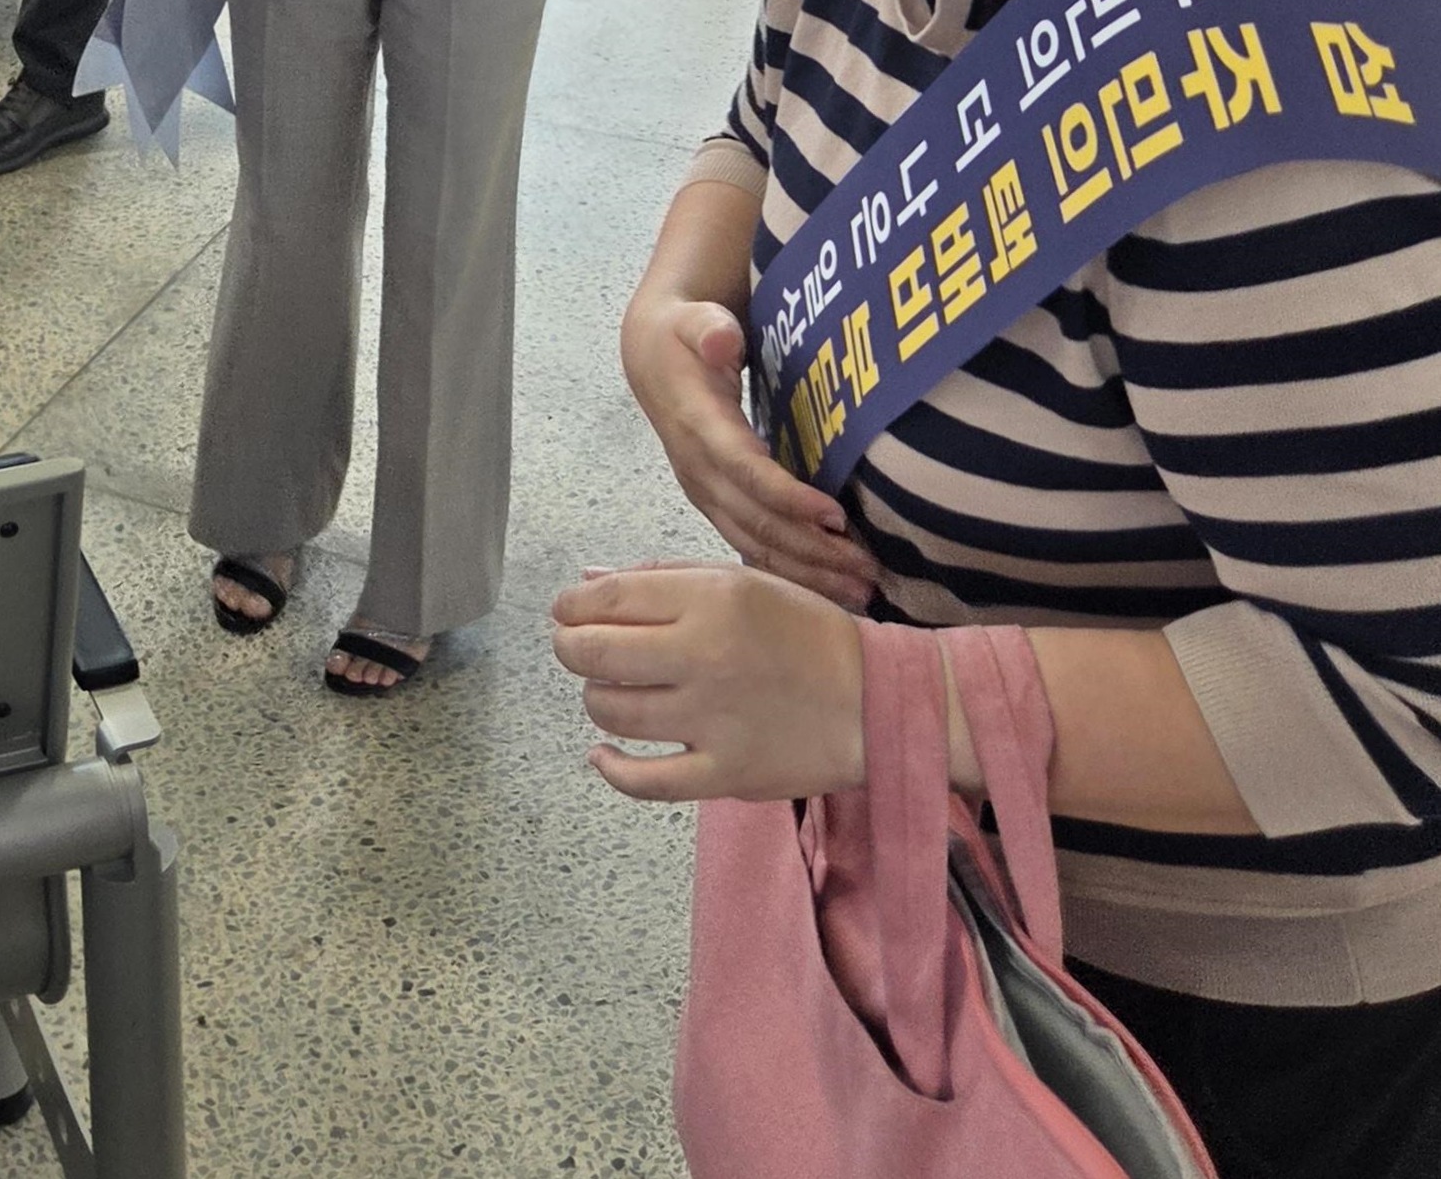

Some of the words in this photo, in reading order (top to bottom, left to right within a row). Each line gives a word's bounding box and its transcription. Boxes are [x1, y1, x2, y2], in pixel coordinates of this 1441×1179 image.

[956, 79, 1001, 172] 더
[1042, 22, 1282, 223] 주민의
[1310, 22, 1416, 124] 섬
[851, 140, 939, 268] 나은
[889, 159, 1039, 363] 택배비
